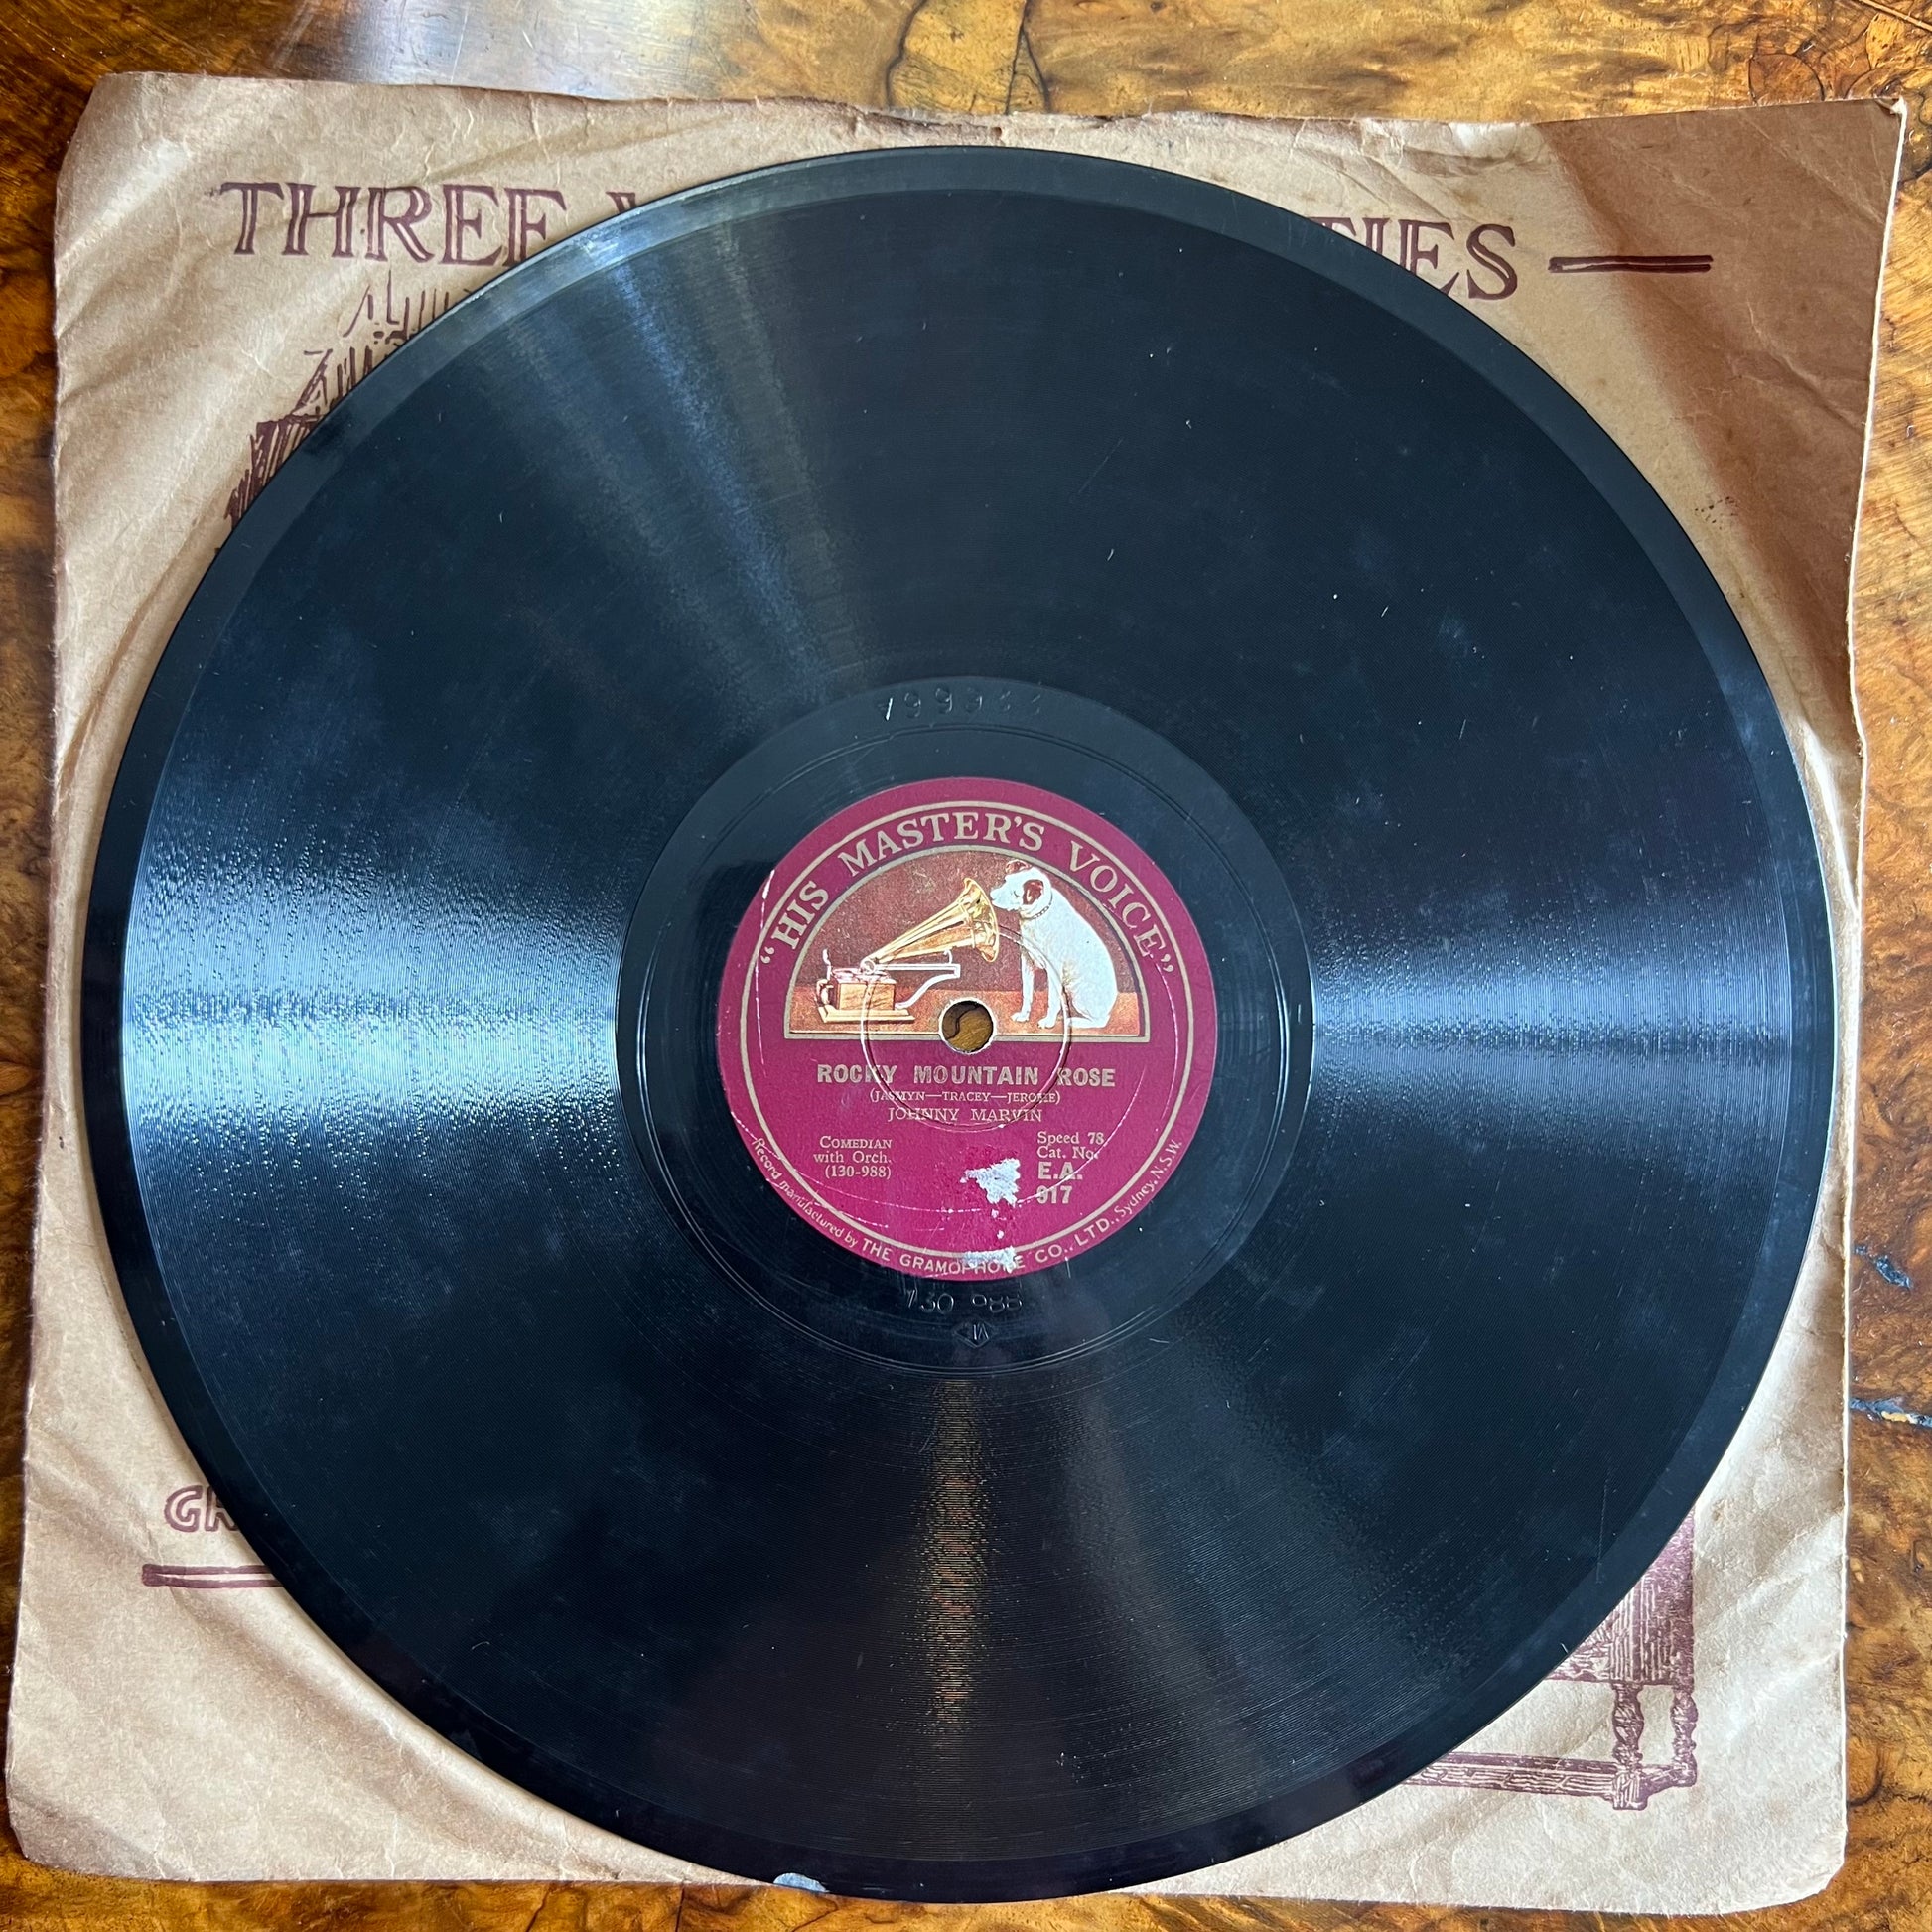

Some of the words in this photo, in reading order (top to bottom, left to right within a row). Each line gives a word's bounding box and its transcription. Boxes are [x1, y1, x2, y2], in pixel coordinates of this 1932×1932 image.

[219, 182, 567, 267] THREE
[817, 1064, 897, 1084] ROCKY
[913, 1065, 1038, 1086] MOUNTAIN
[1057, 1068, 1116, 1087] ROSE
[887, 1108, 960, 1122] JOHNNY
[970, 1108, 1042, 1122] MARVIN
[1037, 1131, 1079, 1146] Speed
[1087, 1132, 1105, 1145] 78
[813, 1150, 844, 1163] with
[852, 1150, 893, 1164] Orch.
[1036, 1146, 1067, 1159] Cat.
[825, 1166, 892, 1179] (130-988)
[1037, 1162, 1083, 1180] E.A.
[752, 1137, 783, 1180] Record
[778, 1180, 845, 1238] manufactured
[844, 1231, 859, 1248] by
[861, 1238, 894, 1262] THE
[1036, 1185, 1072, 1204] 917
